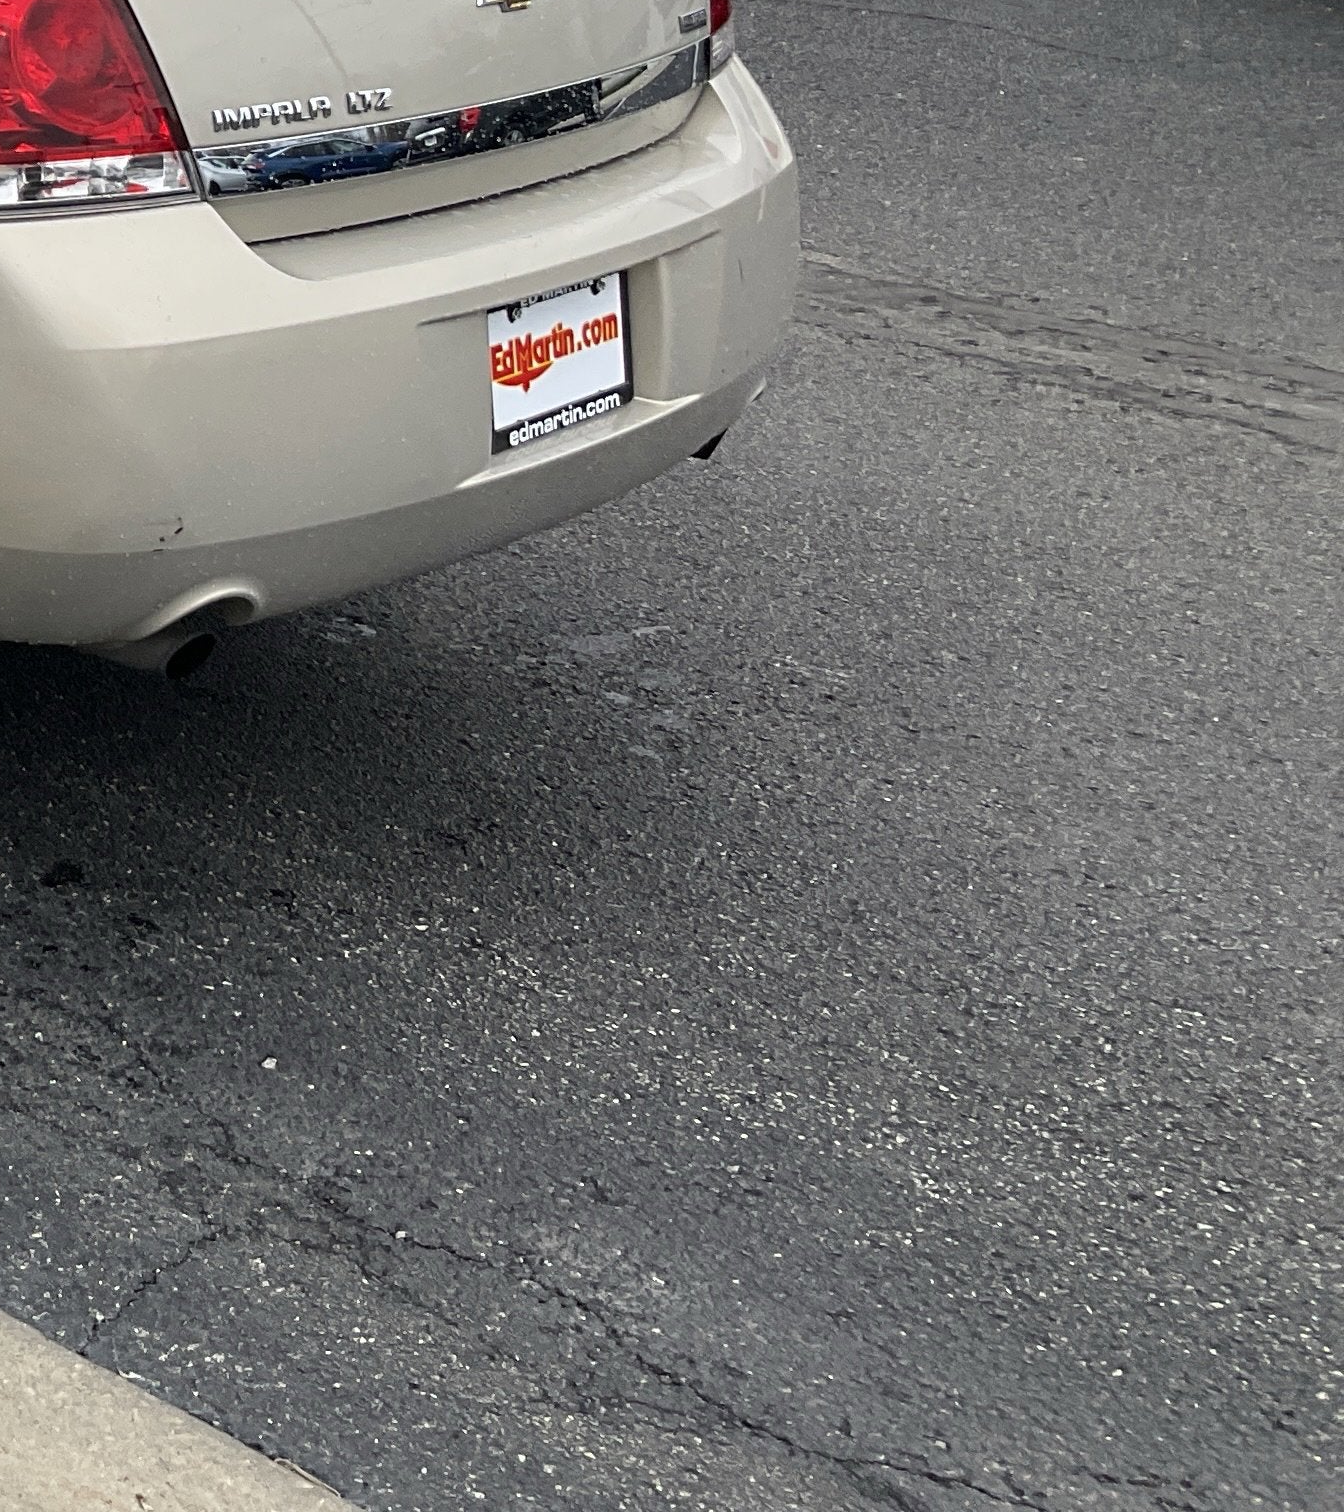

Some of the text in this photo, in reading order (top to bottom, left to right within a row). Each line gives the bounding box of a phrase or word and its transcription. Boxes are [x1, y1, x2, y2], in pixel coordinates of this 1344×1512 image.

[212, 87, 393, 133] IMPALA LTZ
[489, 312, 619, 390] EdMartin.com
[509, 391, 621, 446] edmartin.com
